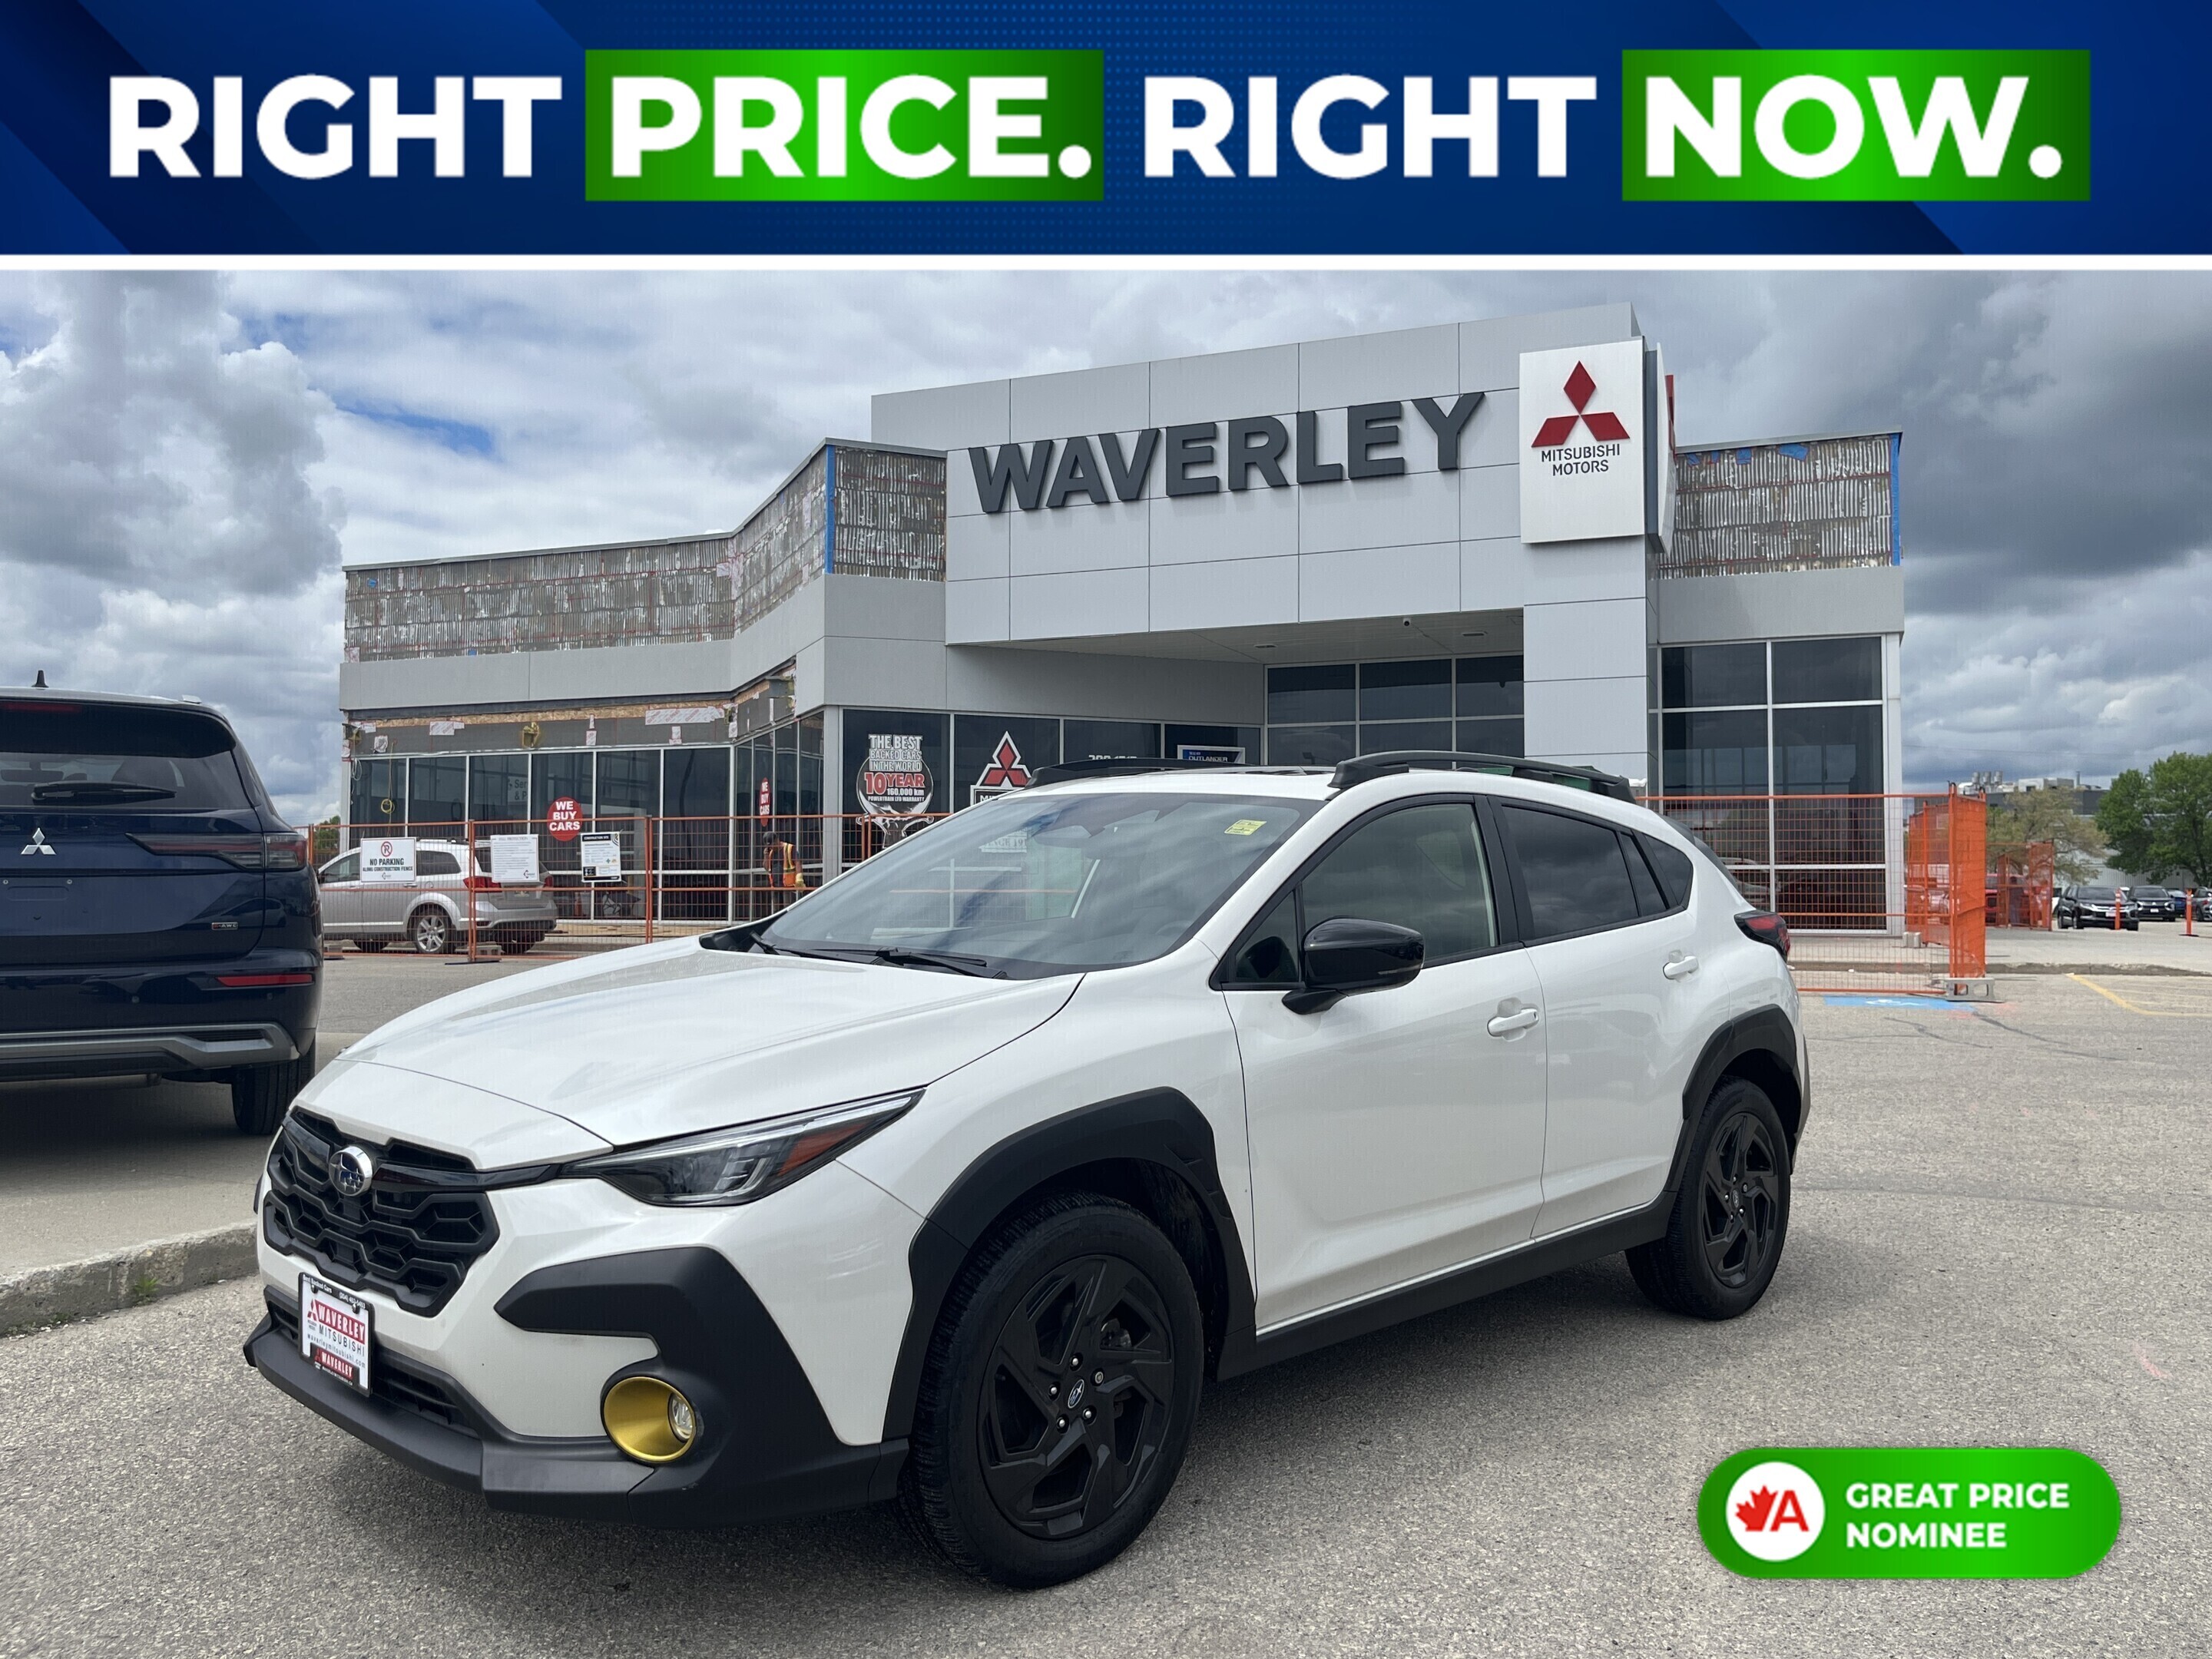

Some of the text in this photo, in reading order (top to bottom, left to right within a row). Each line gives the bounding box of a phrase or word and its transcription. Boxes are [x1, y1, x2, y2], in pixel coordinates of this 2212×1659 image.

[968, 392, 1485, 513] WAVERLEY
[1541, 444, 1620, 462] MITSUBISHI
[1552, 459, 1609, 476] MOTORS
[869, 735, 922, 750] THE BEST
[870, 750, 922, 760] BACKED CARS
[870, 760, 921, 771] IN THE WORLD
[865, 772, 925, 795] 10 YEAR
[556, 801, 574, 810] WE
[553, 811, 577, 820] BUY
[549, 822, 581, 831] CARS
[319, 1304, 365, 1341] WAVERLEY
[320, 1324, 365, 1357] MITSUBISHI
[308, 1334, 366, 1368] waverleymitsubishi.com
[321, 1352, 353, 1377] WAVERLEY
